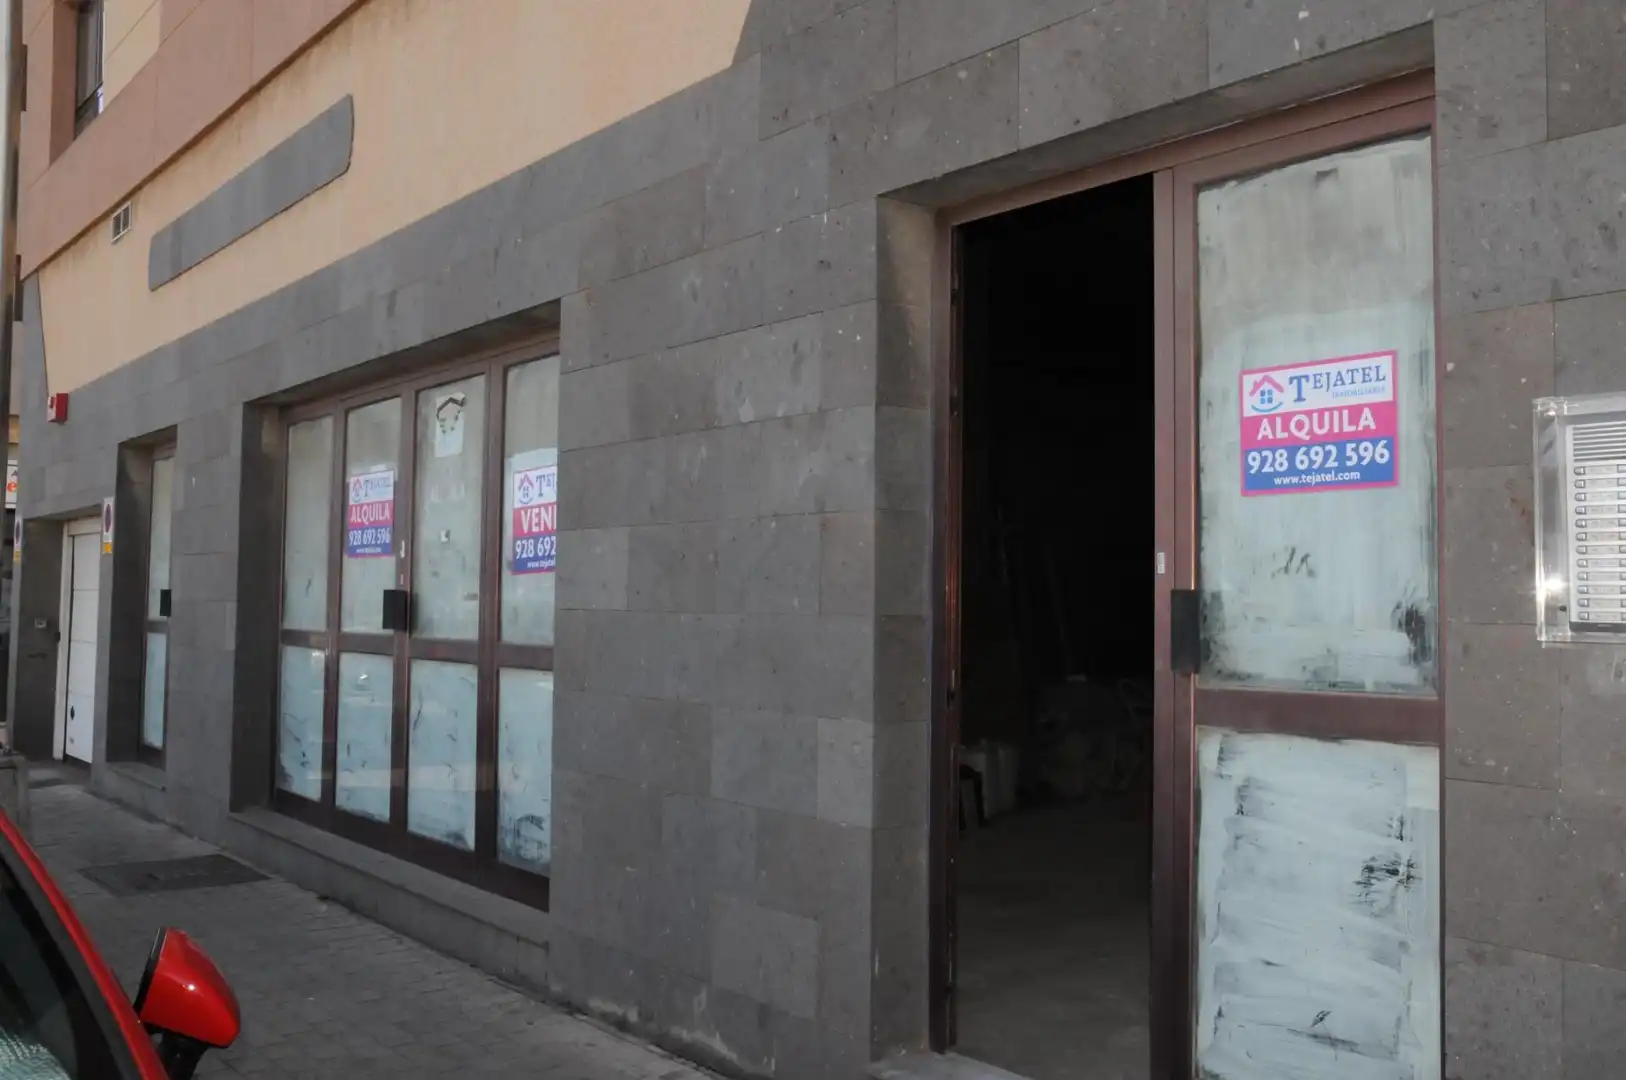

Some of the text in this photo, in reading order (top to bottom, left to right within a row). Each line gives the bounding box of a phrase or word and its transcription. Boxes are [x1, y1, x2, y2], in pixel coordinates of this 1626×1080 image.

[1288, 365, 1387, 403] TEJATEL
[1256, 407, 1377, 441] ALQUILA
[1247, 439, 1390, 475] 928 692 596
[1273, 469, 1361, 486] www.tejatel.com
[351, 503, 389, 525] ALQUILA
[515, 535, 557, 559] 928 692
